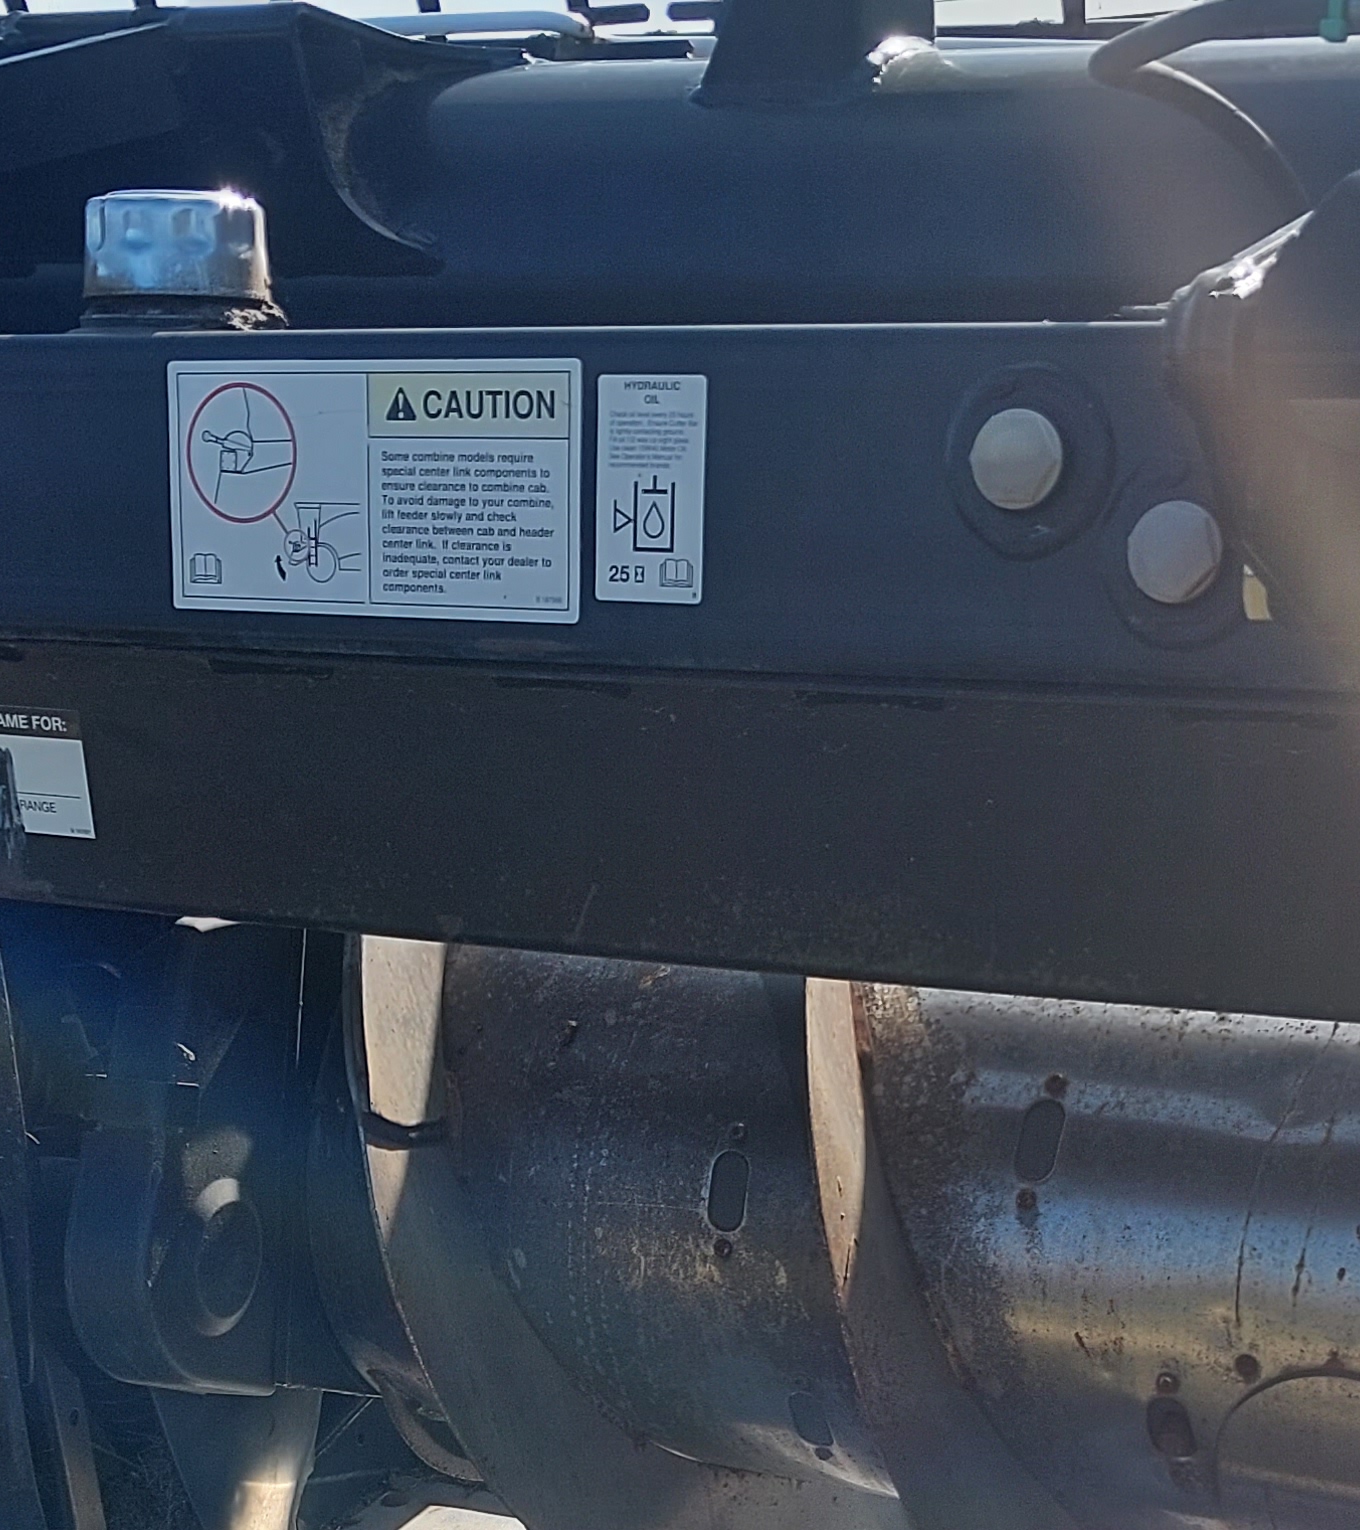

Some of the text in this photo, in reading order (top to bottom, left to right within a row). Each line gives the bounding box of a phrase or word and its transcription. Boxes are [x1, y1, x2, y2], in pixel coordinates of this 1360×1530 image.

[624, 382, 680, 390] HYDRAULIC
[423, 390, 555, 419] CAUTION
[644, 395, 660, 404] OIL
[381, 451, 533, 465] Some combine models require
[382, 466, 550, 478] special center link components to
[382, 482, 549, 493] ensure clearance to combine cab.
[382, 495, 554, 509] To avoid damage to your combine,
[382, 510, 516, 523] lift feeder slowly and check
[382, 524, 554, 537] clearance between cab and header
[382, 539, 511, 551] center link. If clearance is
[382, 554, 551, 568] inadequate, contact your dealer to
[383, 568, 501, 580] order special center link
[609, 565, 630, 582] 25
[383, 583, 446, 594] components.
[31, 716, 67, 731] FOR:
